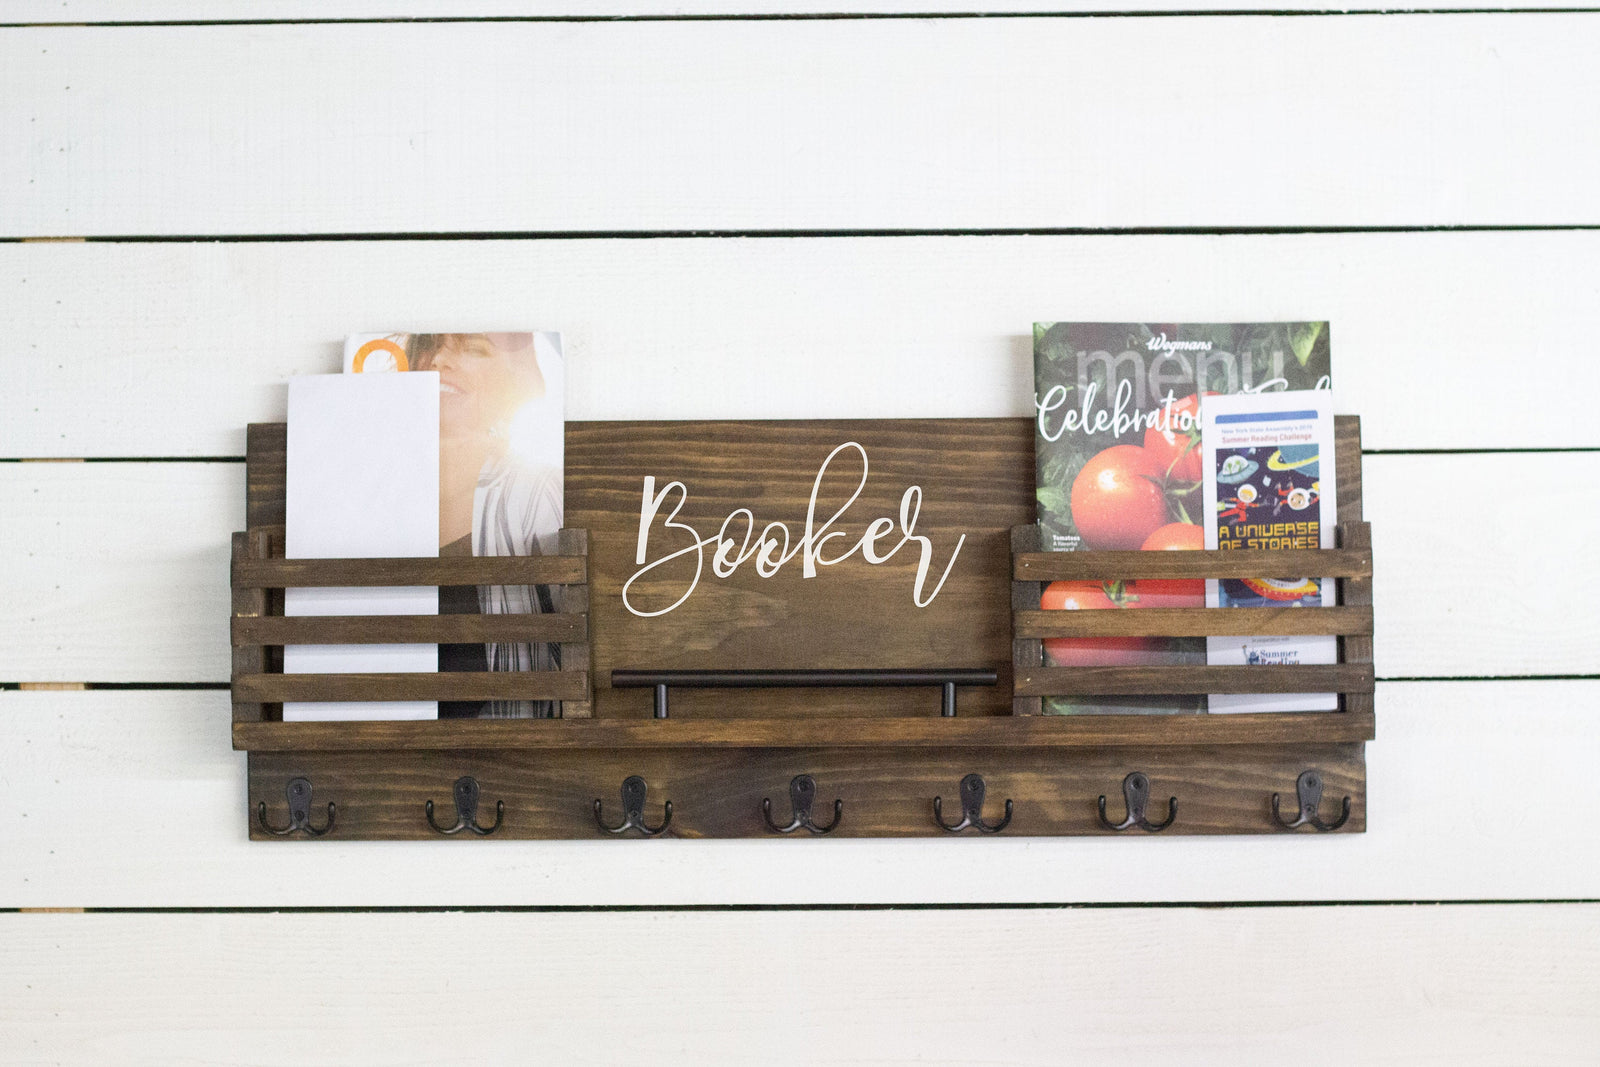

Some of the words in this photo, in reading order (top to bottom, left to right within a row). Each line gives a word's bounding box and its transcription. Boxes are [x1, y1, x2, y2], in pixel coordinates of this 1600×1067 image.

[1146, 333, 1213, 357] Wegmans
[1076, 349, 1284, 408] menu
[1222, 436, 1249, 444] Summer
[1251, 434, 1278, 443] Reading
[1279, 433, 1312, 441] Challenge
[622, 441, 966, 617] Booker
[1219, 526, 1229, 538] A
[1236, 521, 1319, 537] UNIVERSE
[1219, 540, 1241, 550] OF
[1248, 537, 1318, 550] STORIES
[1260, 649, 1298, 658] Summer
